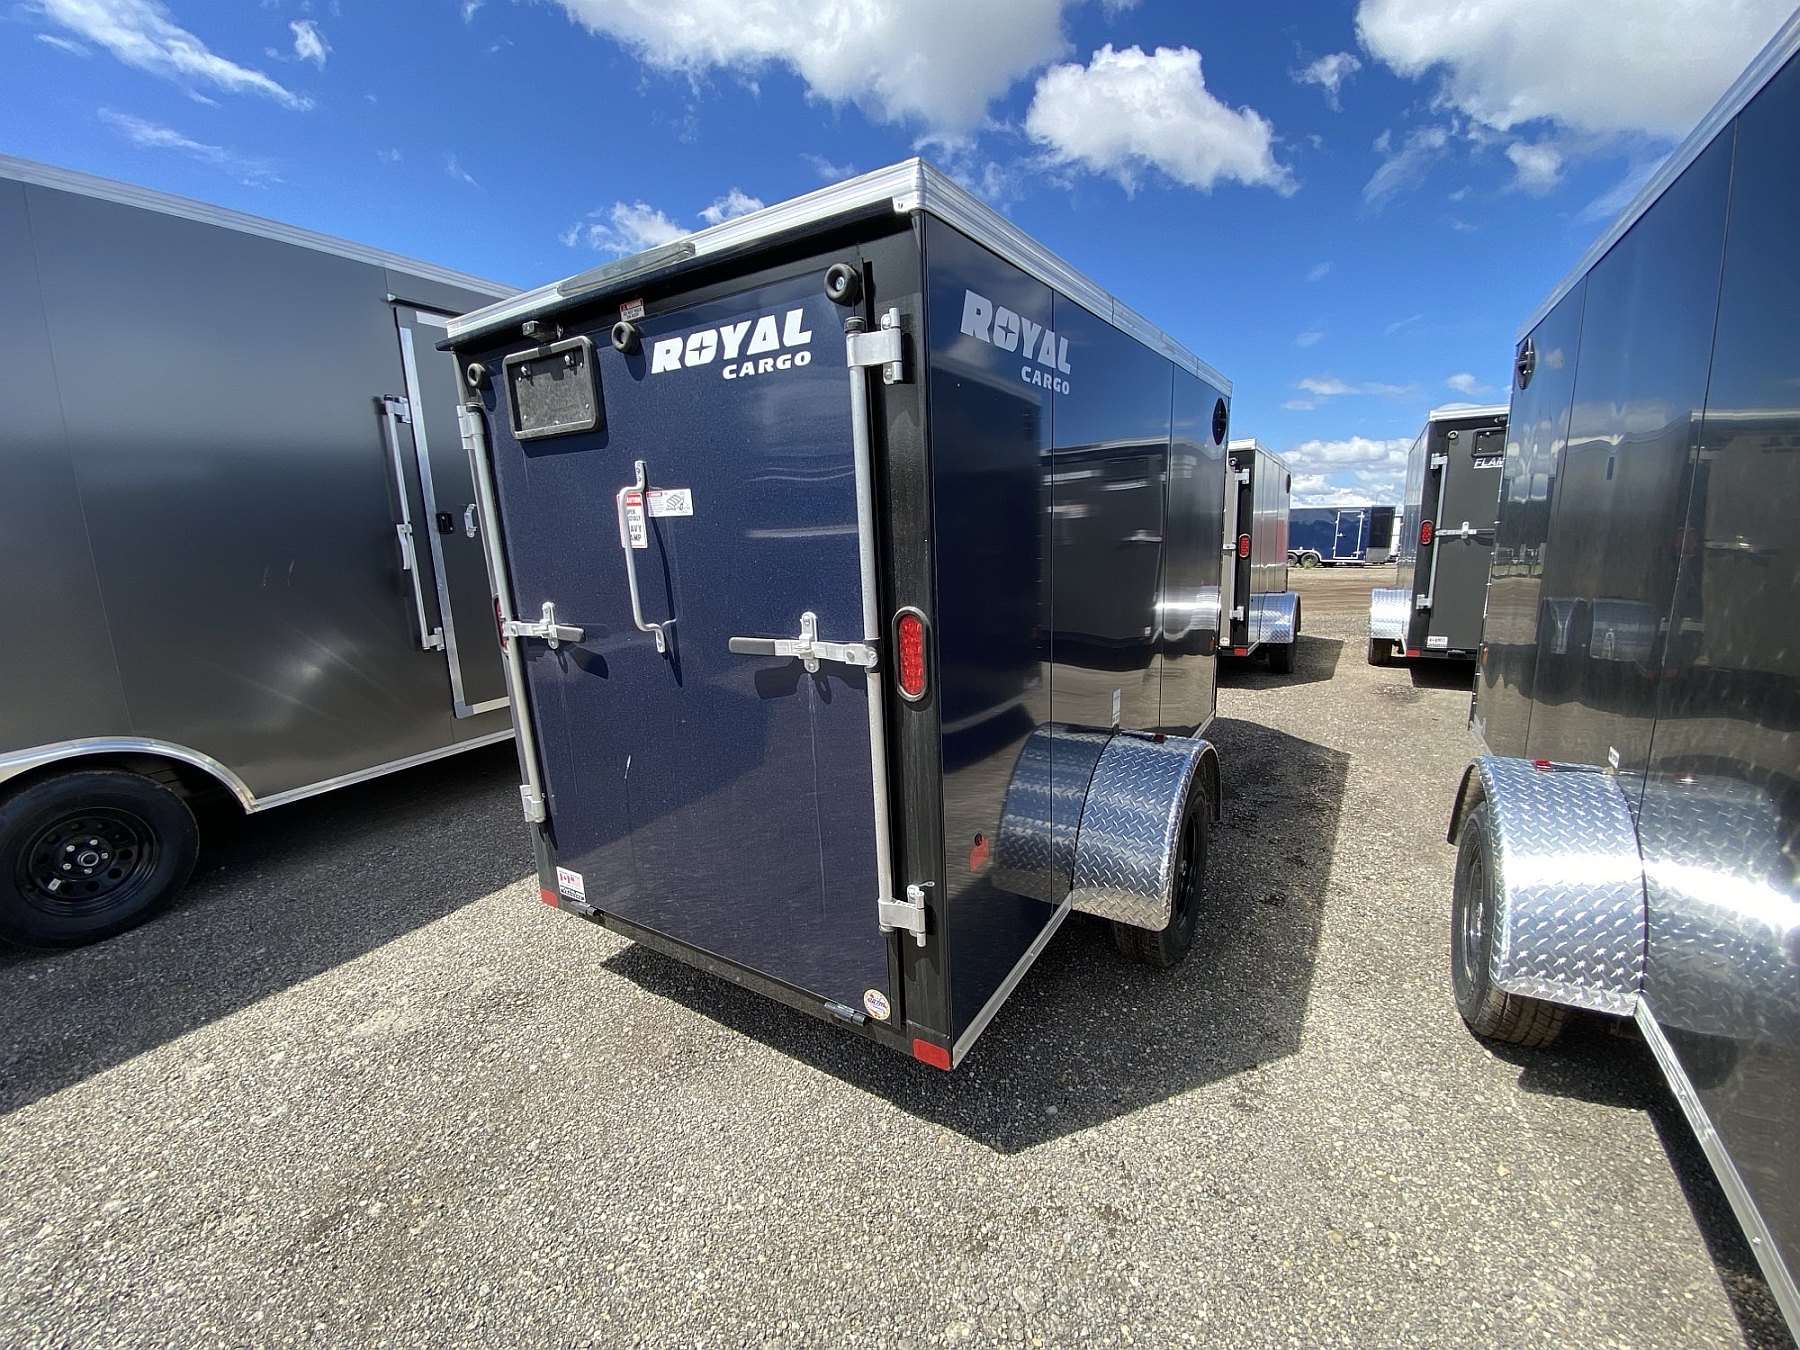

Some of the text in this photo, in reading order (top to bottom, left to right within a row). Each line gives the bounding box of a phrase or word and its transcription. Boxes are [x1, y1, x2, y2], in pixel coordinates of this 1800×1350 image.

[651, 308, 812, 374] ROYAL
[960, 288, 1071, 375] ROYAL
[722, 351, 812, 380] CARGO
[1021, 365, 1070, 395] CARGO
